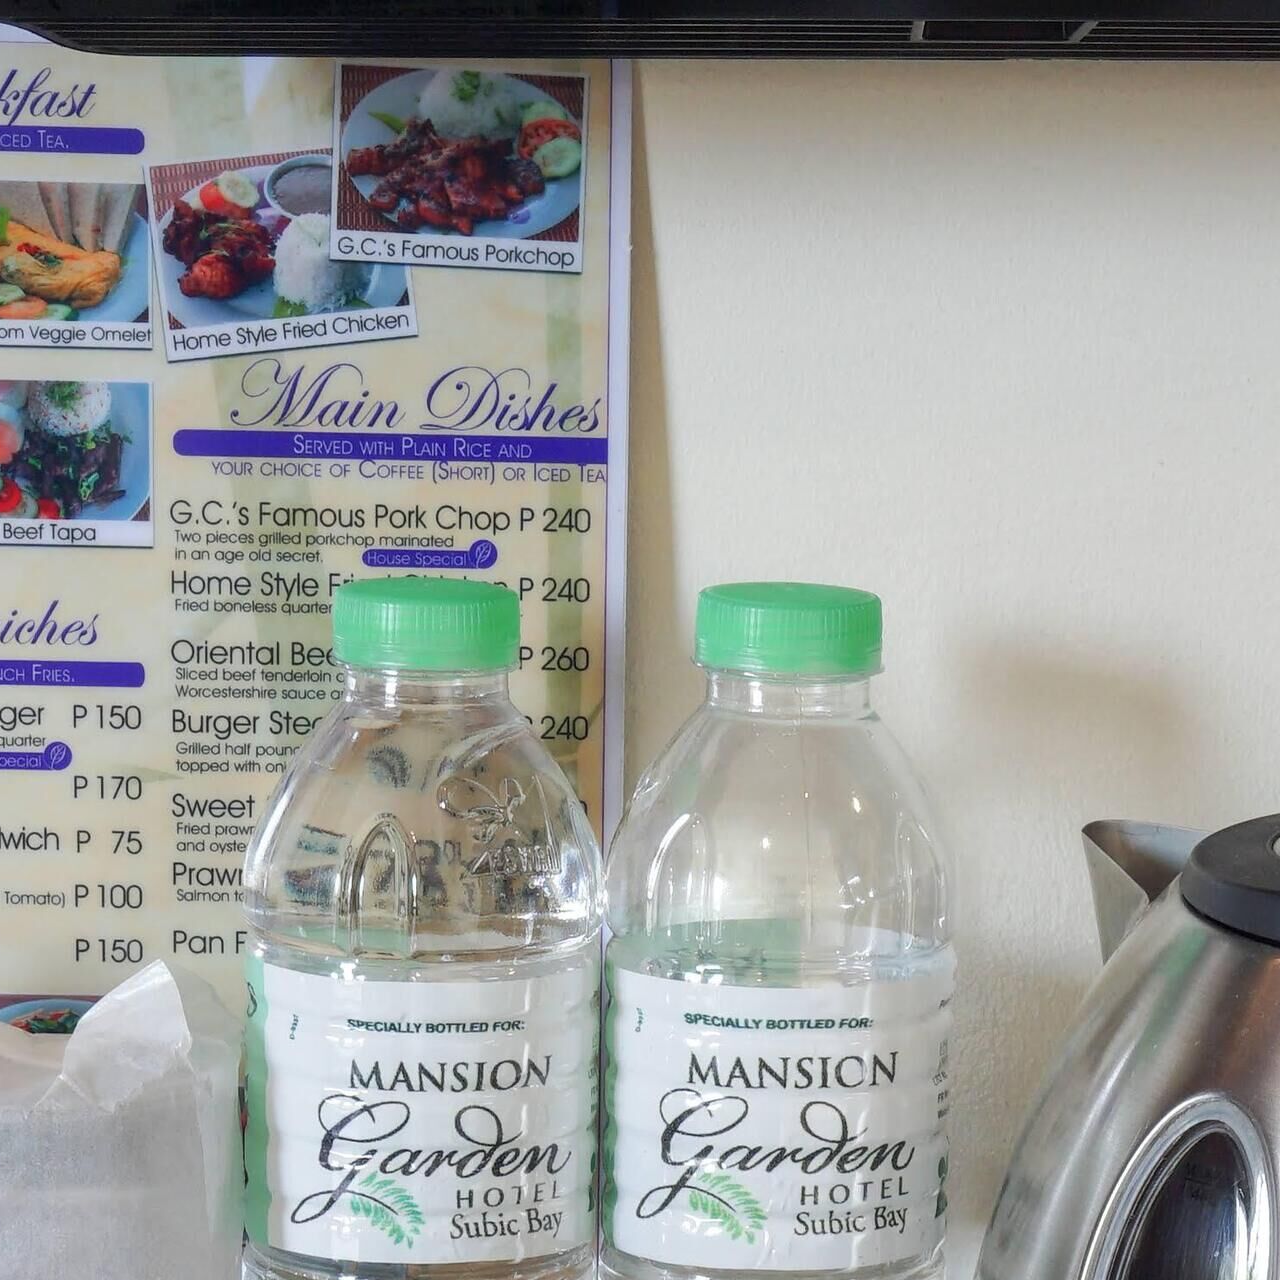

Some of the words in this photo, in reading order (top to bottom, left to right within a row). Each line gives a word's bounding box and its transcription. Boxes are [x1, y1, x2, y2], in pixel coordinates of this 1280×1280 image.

[338, 237, 396, 257] G.C.'s
[401, 240, 479, 262] Famous
[485, 243, 575, 268] Porkchop
[29, 326, 87, 344] Veggie
[91, 327, 151, 343] Omelet
[173, 330, 231, 352] Home
[236, 325, 277, 348] Style
[283, 320, 327, 342] Fried
[332, 312, 410, 334] Chicken
[230, 358, 406, 429] Main
[420, 365, 601, 433] Dishes
[170, 500, 249, 526] G.C.'s
[259, 502, 365, 529] Famous
[375, 504, 426, 530] Pork
[435, 506, 511, 536] Chop
[542, 508, 591, 533] 240
[3, 523, 44, 540] Beef
[49, 524, 96, 543] Tapa
[174, 531, 201, 545] Two
[205, 531, 254, 548] pieces
[259, 531, 301, 549] grilled
[307, 532, 375, 550] porkchop
[379, 535, 454, 549] marinated
[174, 548, 186, 562] in
[191, 551, 210, 562] an
[214, 551, 245, 566] age
[248, 549, 271, 563] old
[276, 550, 323, 563] secret.
[171, 570, 252, 597] Home
[260, 571, 319, 603] Style
[174, 599, 208, 613] Fried
[213, 600, 277, 614] boneless
[281, 600, 333, 617] quarter
[171, 639, 280, 666] Oriental
[175, 667, 218, 681] Sliced
[223, 668, 256, 682] beef
[261, 669, 331, 683] tenderloin
[175, 684, 277, 699] Worcestershire
[281, 688, 325, 700] sauce
[172, 709, 260, 740] Burger
[176, 742, 220, 756] Grilled
[225, 743, 251, 756] half
[176, 759, 229, 774] topped
[234, 760, 261, 773] with
[172, 793, 256, 819] Sweet
[176, 822, 210, 835] Fried
[176, 840, 204, 852] and
[176, 889, 229, 902] Salmon
[347, 1019, 422, 1034] SPECIALLY
[425, 1020, 489, 1034] BOTTLED
[492, 1019, 525, 1032] FOR:
[684, 1012, 762, 1030] SPECIALLY
[766, 1017, 835, 1030] BOTTLED
[839, 1017, 873, 1029] FOR:
[348, 1054, 552, 1092] MANSION
[686, 1051, 898, 1089] MANSION
[290, 1094, 573, 1224] Garden
[636, 1087, 915, 1219] Garden
[456, 1180, 561, 1208] HOTEL
[801, 1175, 909, 1206] HOTEL
[449, 1211, 520, 1239] Subic
[527, 1208, 563, 1238] Bay
[793, 1210, 866, 1237] Subic
[874, 1206, 908, 1234] Bay
